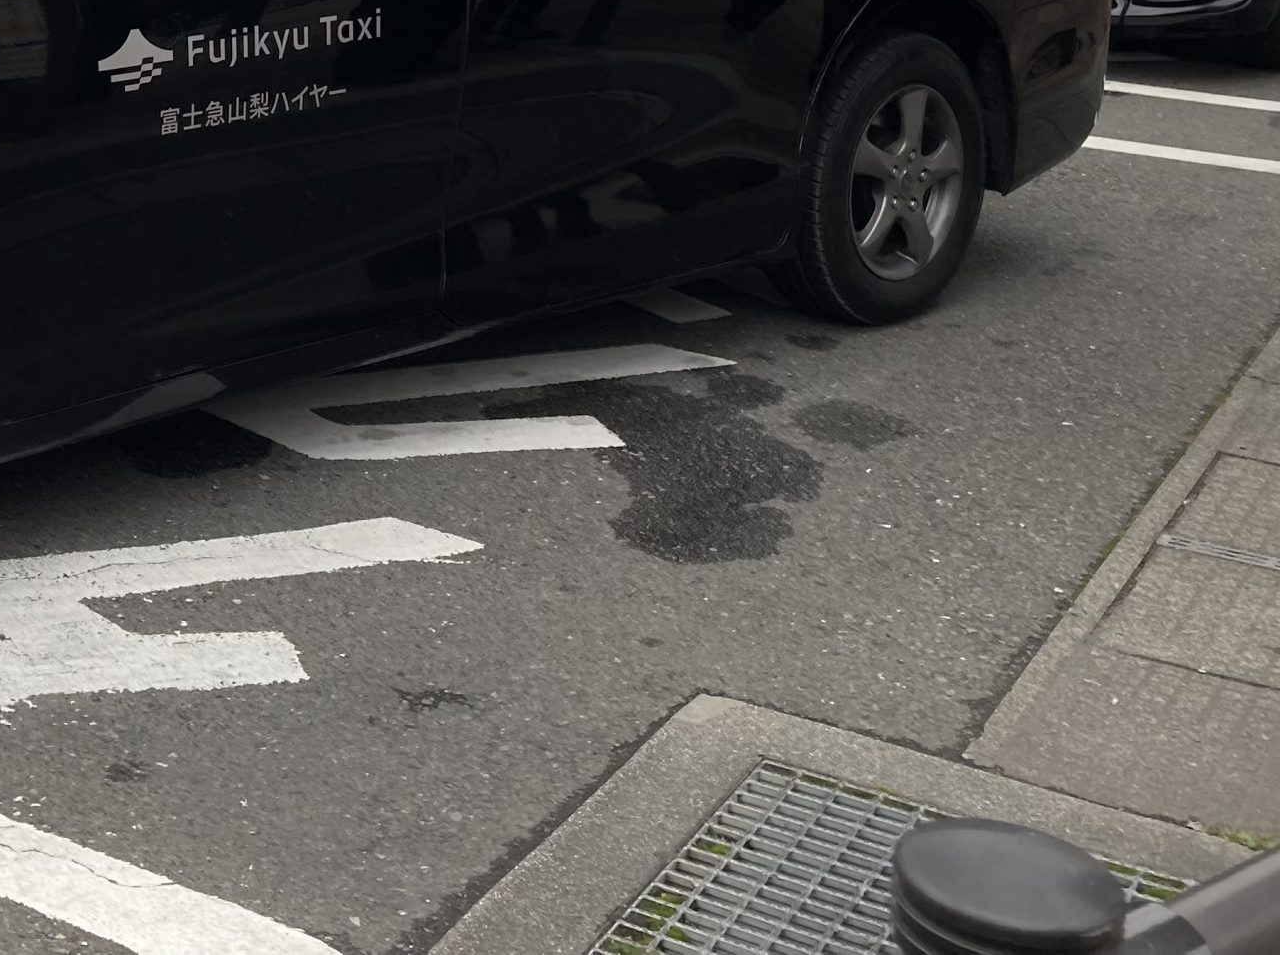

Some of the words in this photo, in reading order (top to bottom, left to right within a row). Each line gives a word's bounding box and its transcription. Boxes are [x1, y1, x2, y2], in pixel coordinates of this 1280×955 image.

[187, 24, 309, 68] Fujikyu
[319, 7, 382, 46] Taxi
[159, 83, 347, 136] 富士急山梨ハイヤー
